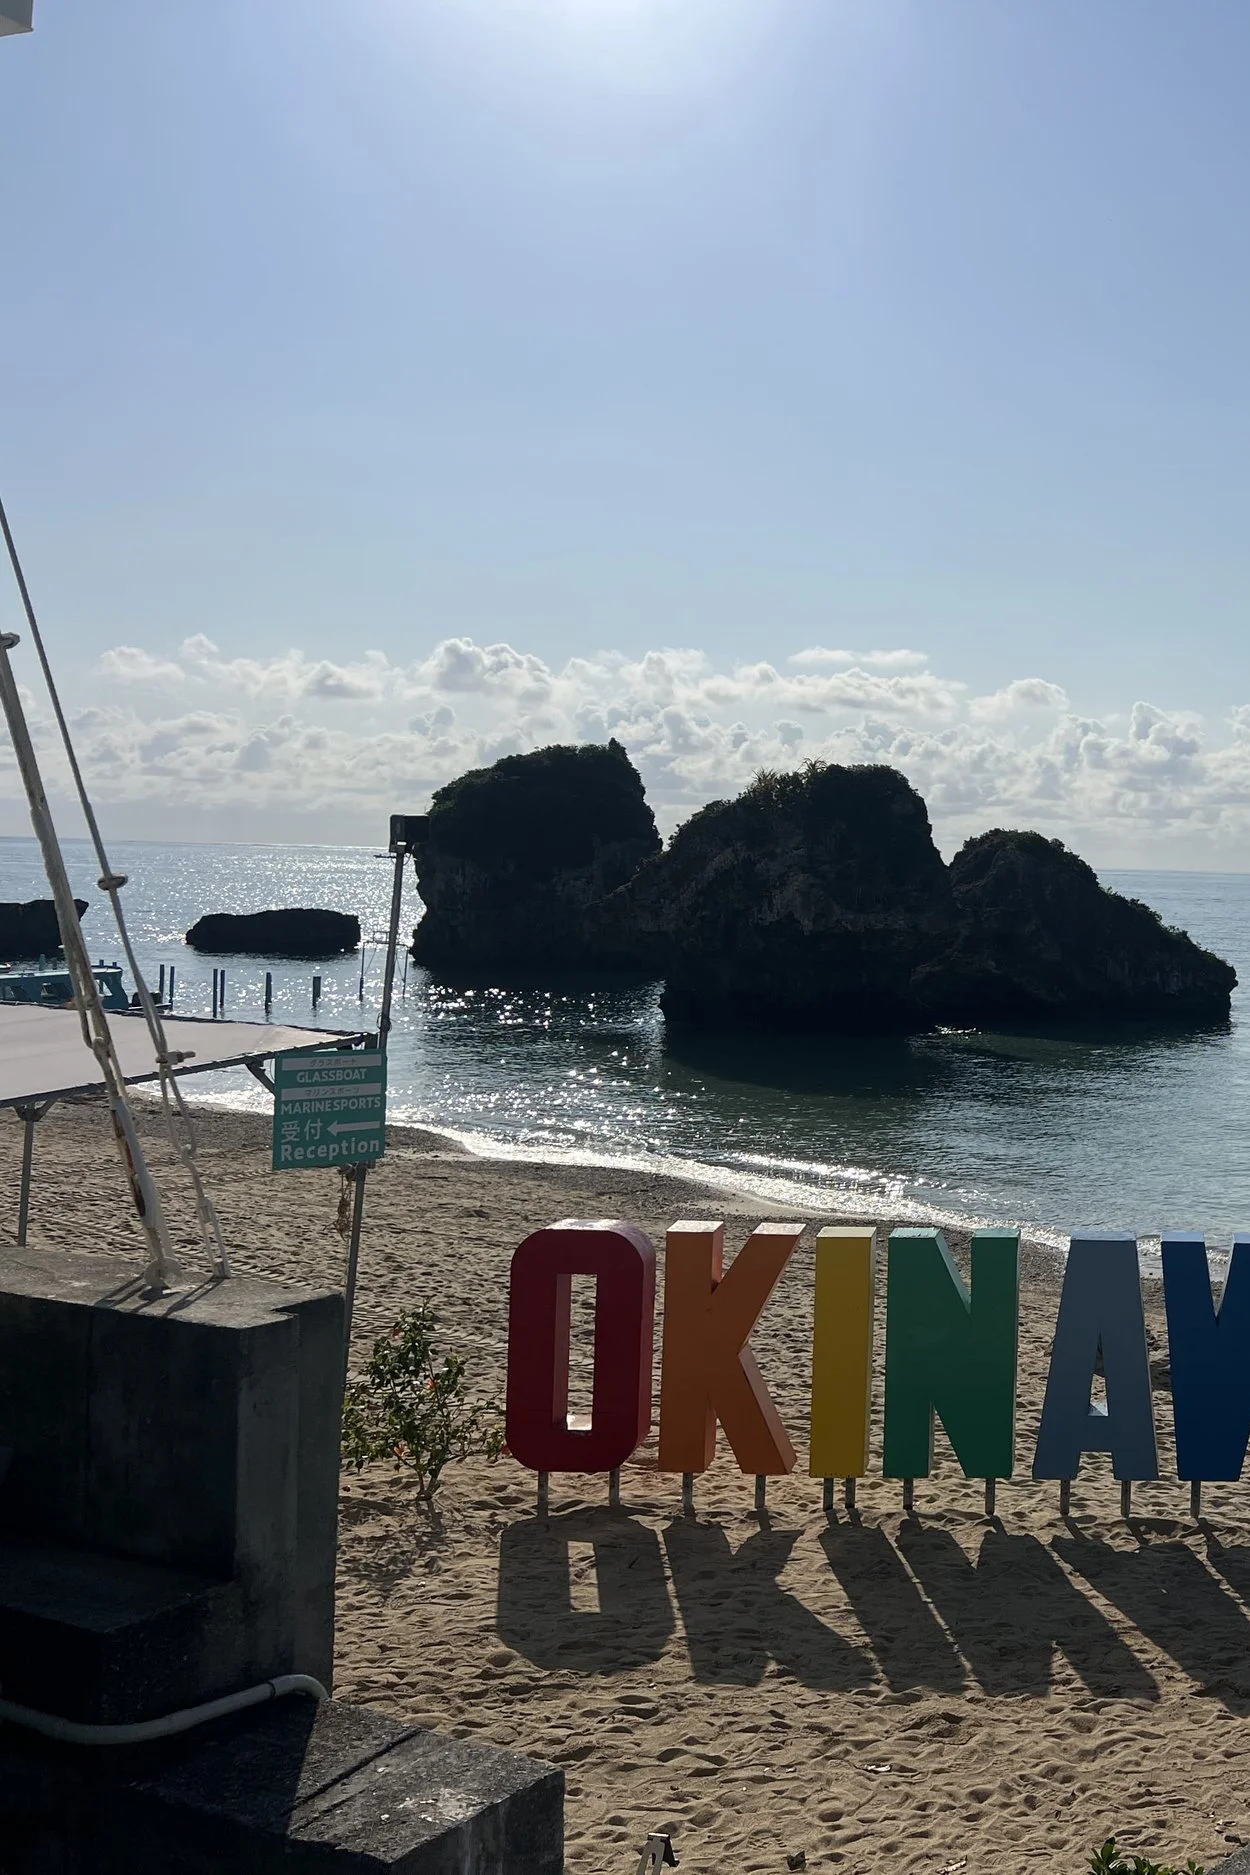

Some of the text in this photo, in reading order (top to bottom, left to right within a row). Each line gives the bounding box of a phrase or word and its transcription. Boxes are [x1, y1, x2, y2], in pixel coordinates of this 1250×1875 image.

[296, 1068, 367, 1083] GLASSBOAT
[281, 1119, 323, 1143] 受付
[280, 1137, 380, 1161] Reception
